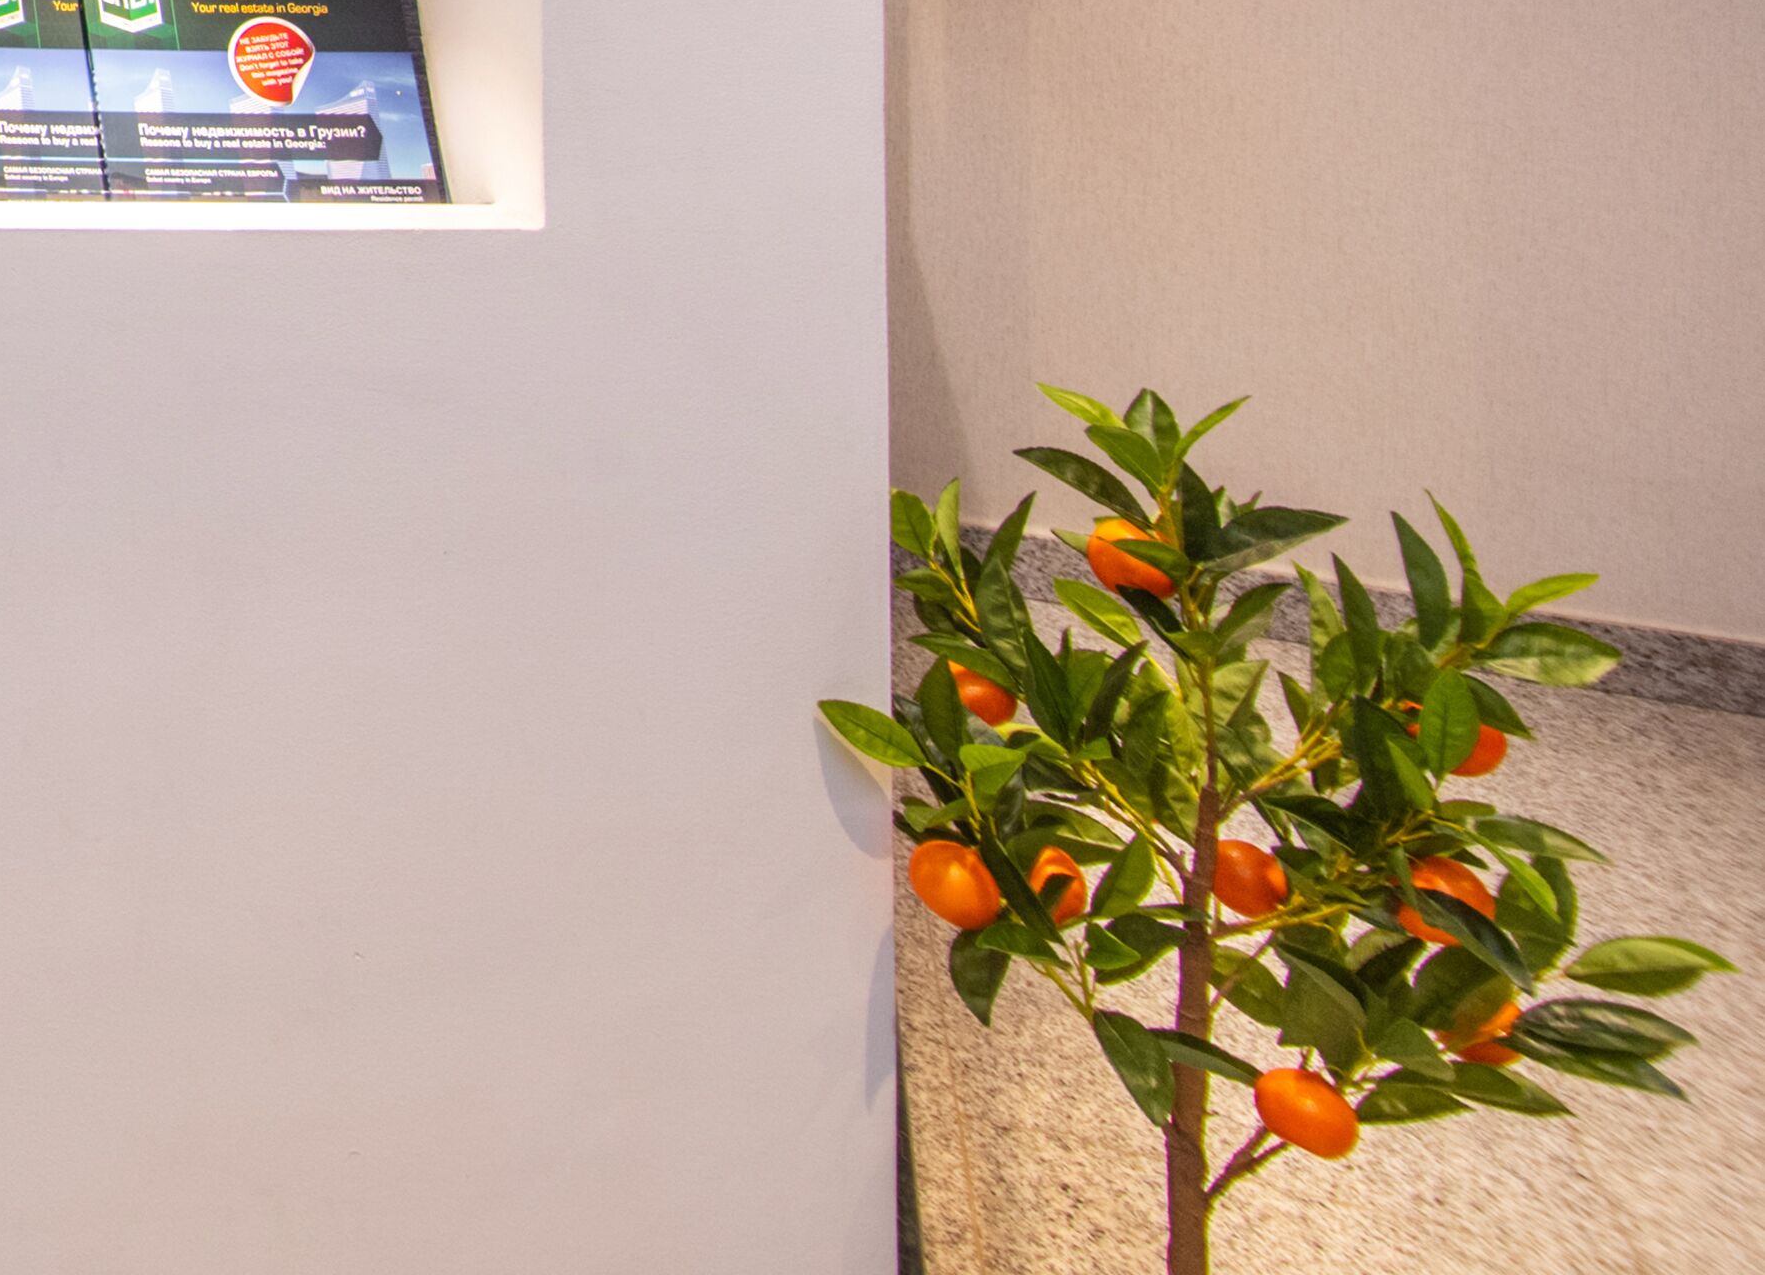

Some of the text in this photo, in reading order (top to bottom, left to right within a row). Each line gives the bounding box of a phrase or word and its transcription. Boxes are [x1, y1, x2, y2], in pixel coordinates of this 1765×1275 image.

[191, 2, 328, 16] Your real estate in Georgia
[138, 123, 366, 140] Почему недвижимость в Грузии?
[41, 135, 51, 146] to
[52, 136, 70, 147] buy
[140, 137, 181, 147] Reasons
[183, 137, 193, 148] to
[193, 138, 212, 149] buy
[222, 138, 240, 148] real
[242, 139, 271, 148] estate
[273, 139, 283, 148] in
[285, 139, 326, 150] Georgia:
[320, 186, 422, 196] ВИД НА ЖИТЕЛЬСТВО
